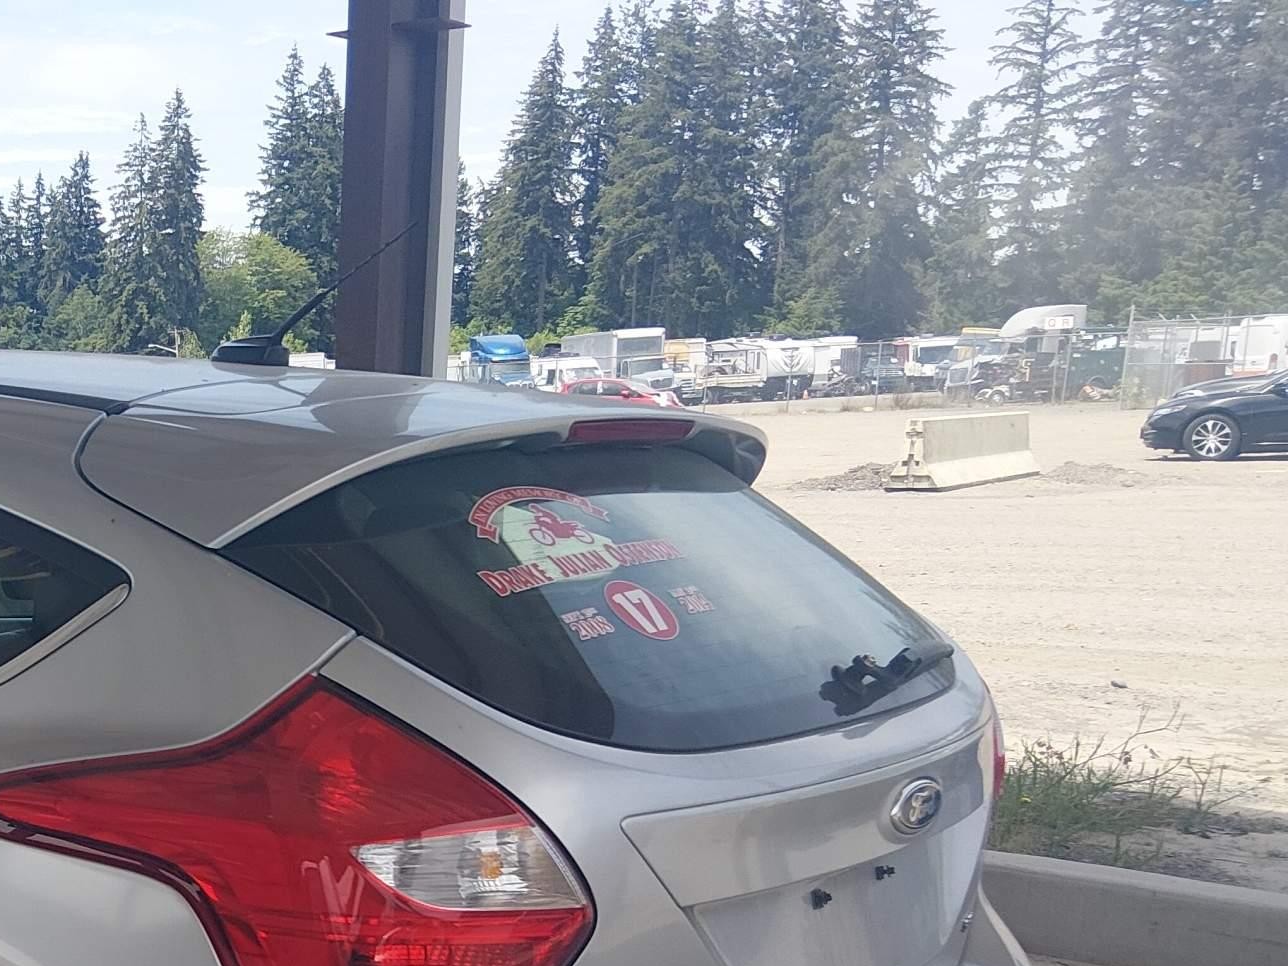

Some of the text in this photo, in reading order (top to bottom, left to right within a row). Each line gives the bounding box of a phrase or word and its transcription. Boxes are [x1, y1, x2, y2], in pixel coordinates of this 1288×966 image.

[479, 562, 554, 594] DRAKE
[547, 549, 612, 577] JULIAN
[612, 589, 669, 634] 17
